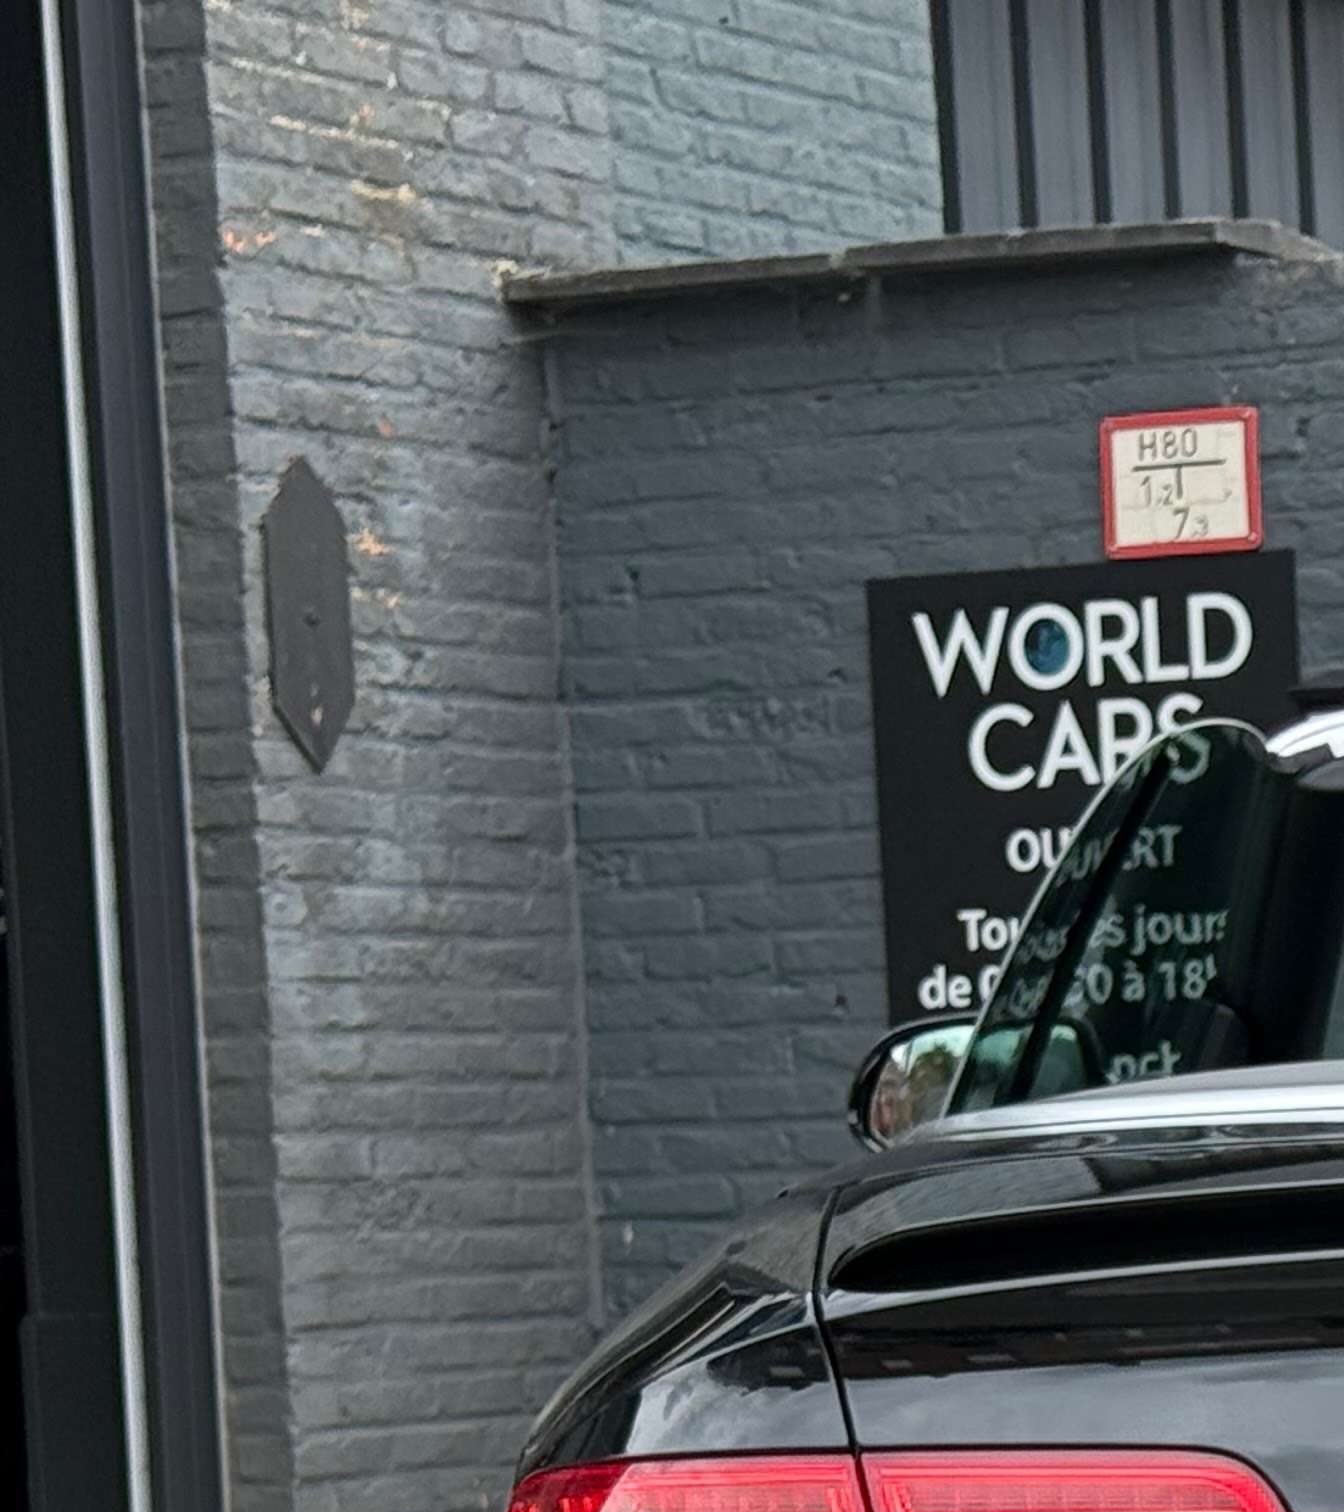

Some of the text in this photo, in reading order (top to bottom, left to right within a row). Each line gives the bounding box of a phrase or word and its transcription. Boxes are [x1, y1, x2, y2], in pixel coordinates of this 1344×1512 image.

[1137, 428, 1198, 461] H80
[911, 592, 1253, 699] WORLD
[918, 964, 972, 1010] de
